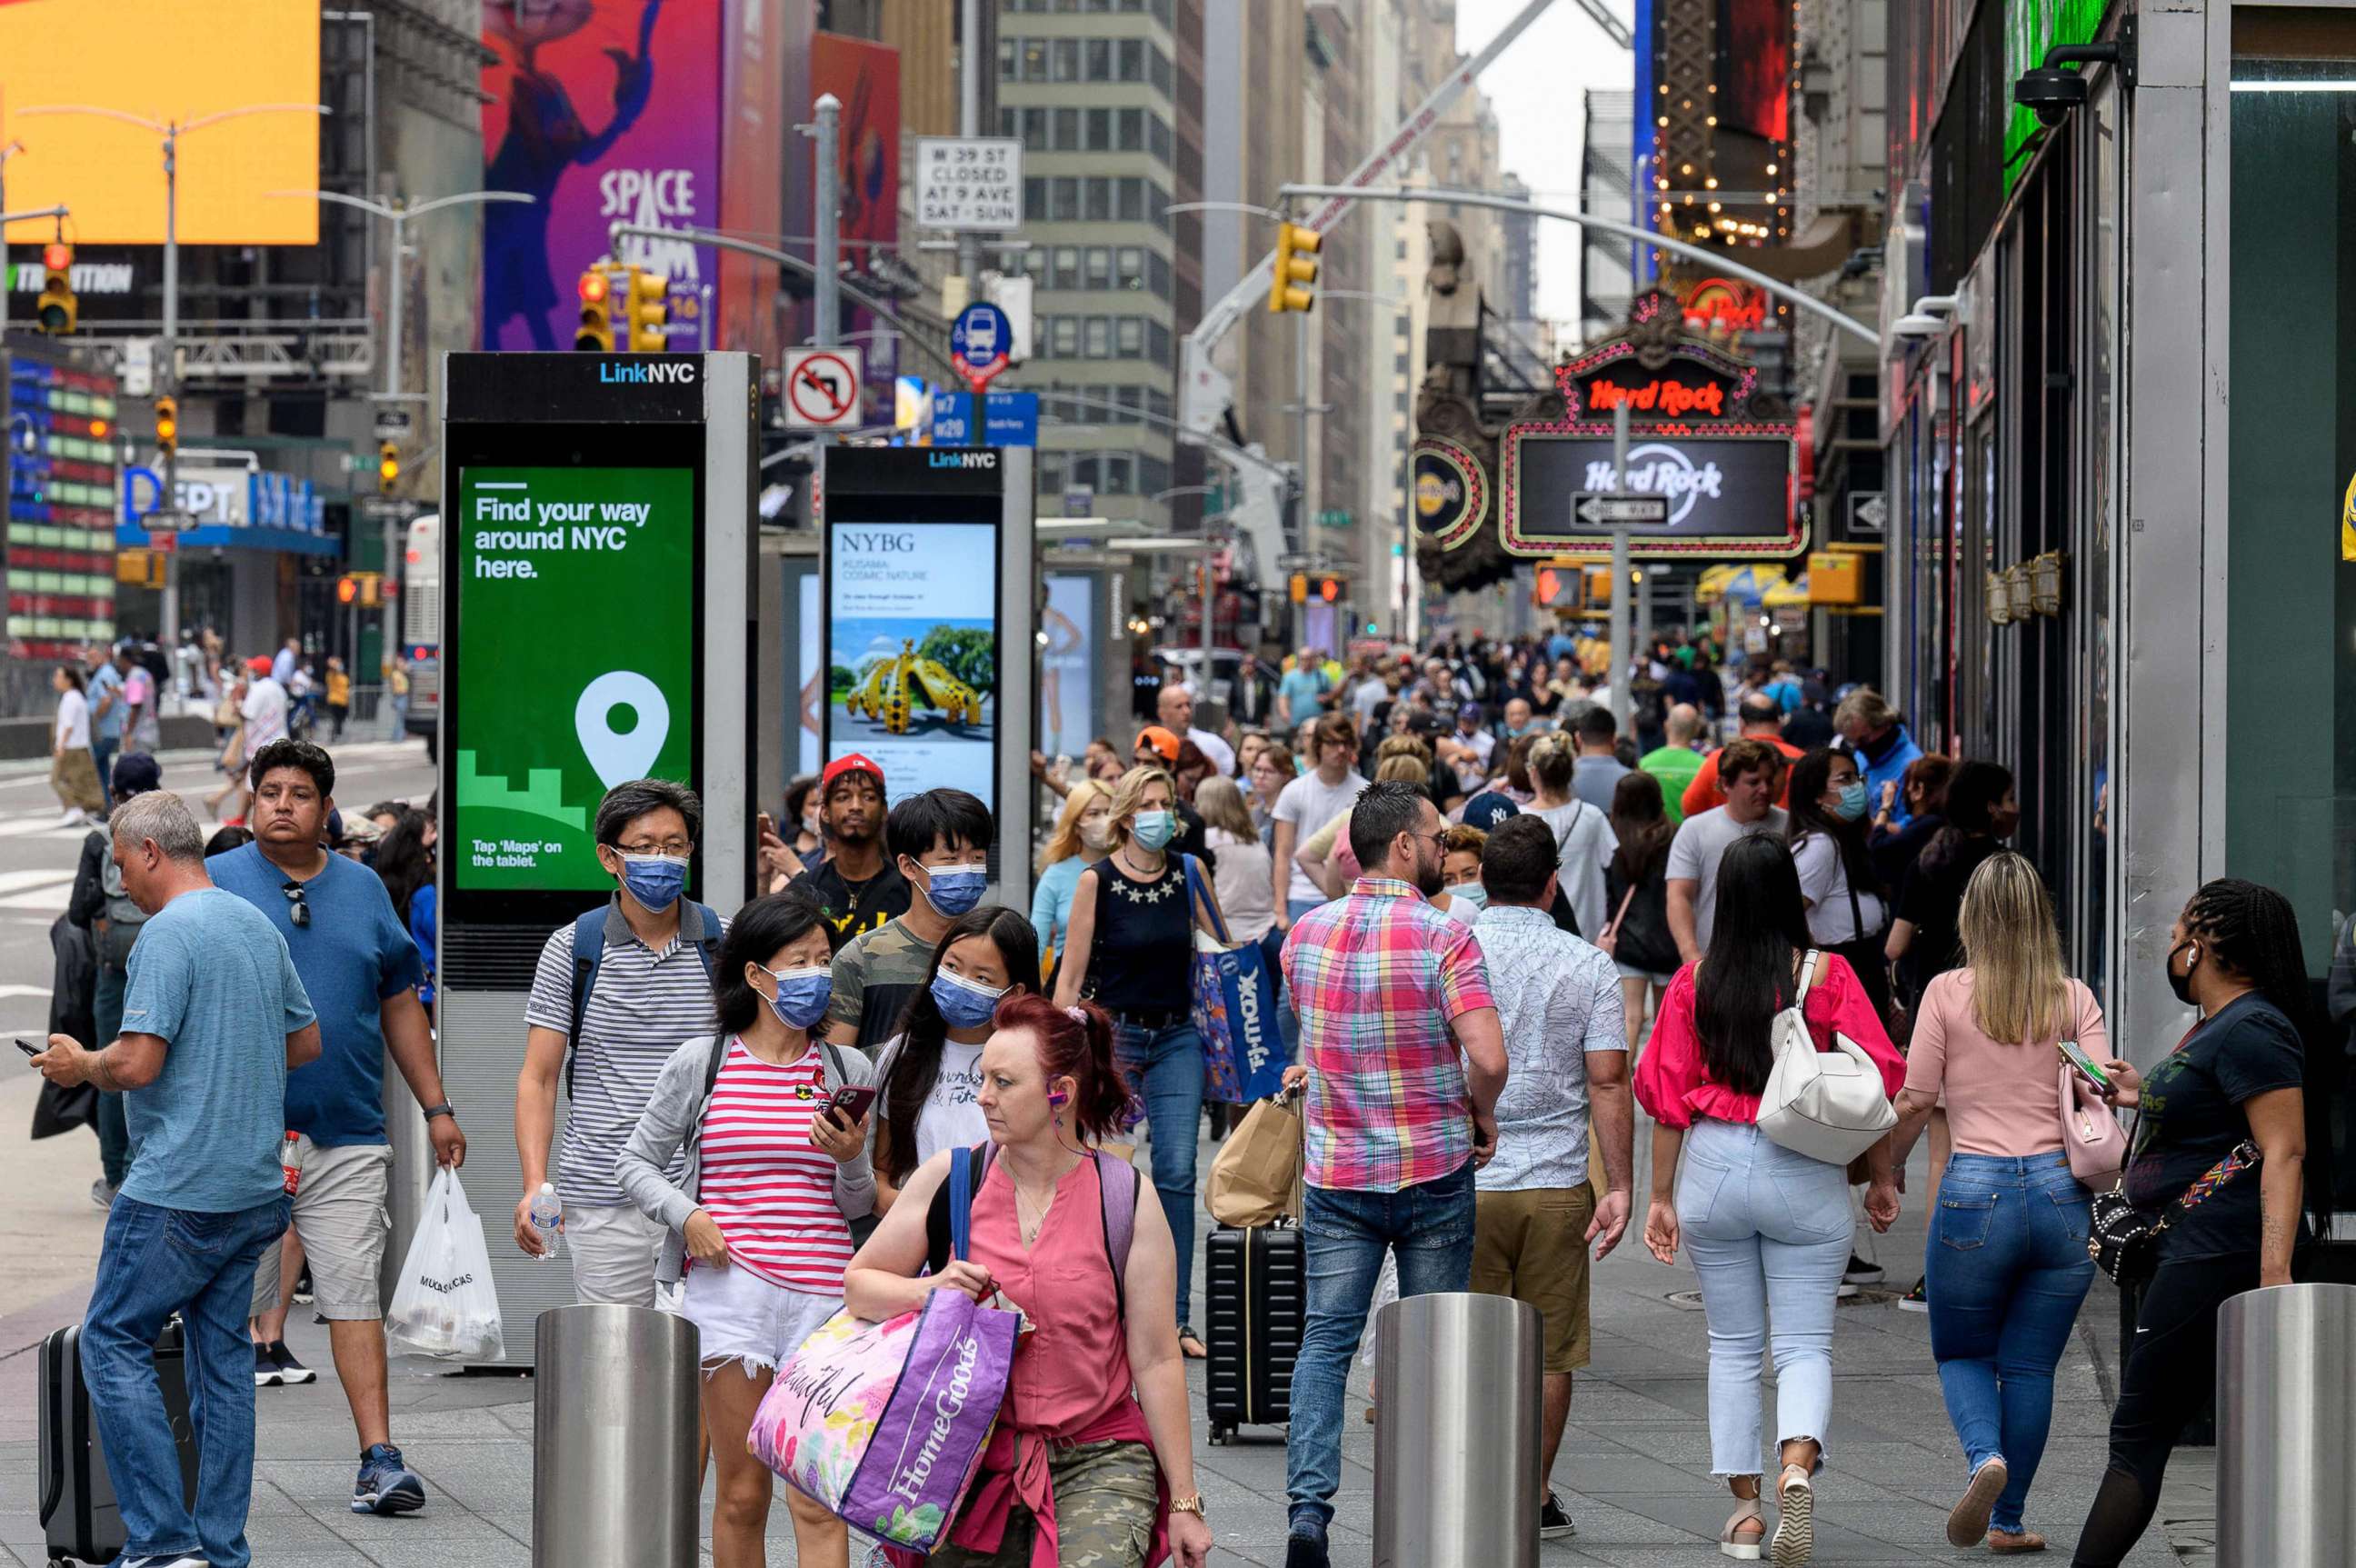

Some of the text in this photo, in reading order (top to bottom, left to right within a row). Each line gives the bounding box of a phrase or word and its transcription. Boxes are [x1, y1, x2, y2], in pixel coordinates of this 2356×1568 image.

[954, 147, 978, 163] 39
[984, 147, 1005, 163] ST
[932, 166, 1007, 183] CLOSED
[599, 168, 696, 216] SPACE
[926, 185, 948, 199] AT
[975, 186, 1013, 202] AVE
[925, 204, 960, 219] SAT
[974, 205, 1014, 220] SUN
[17, 263, 133, 293] TRITION
[600, 364, 694, 383] LinkNYC
[1591, 380, 1723, 417] Hard Rock
[929, 452, 996, 468] LinkNYC
[1655, 461, 1723, 499] Rock
[476, 498, 651, 527] Find your way
[1866, 507, 1885, 517] ON
[475, 526, 627, 550] around NYC
[842, 533, 914, 553] NYBG
[475, 555, 538, 579] here.
[472, 839, 496, 855] Tap
[544, 842, 563, 853] on
[472, 854, 537, 867] the tablet.
[893, 1336, 979, 1505] HomeGoods
